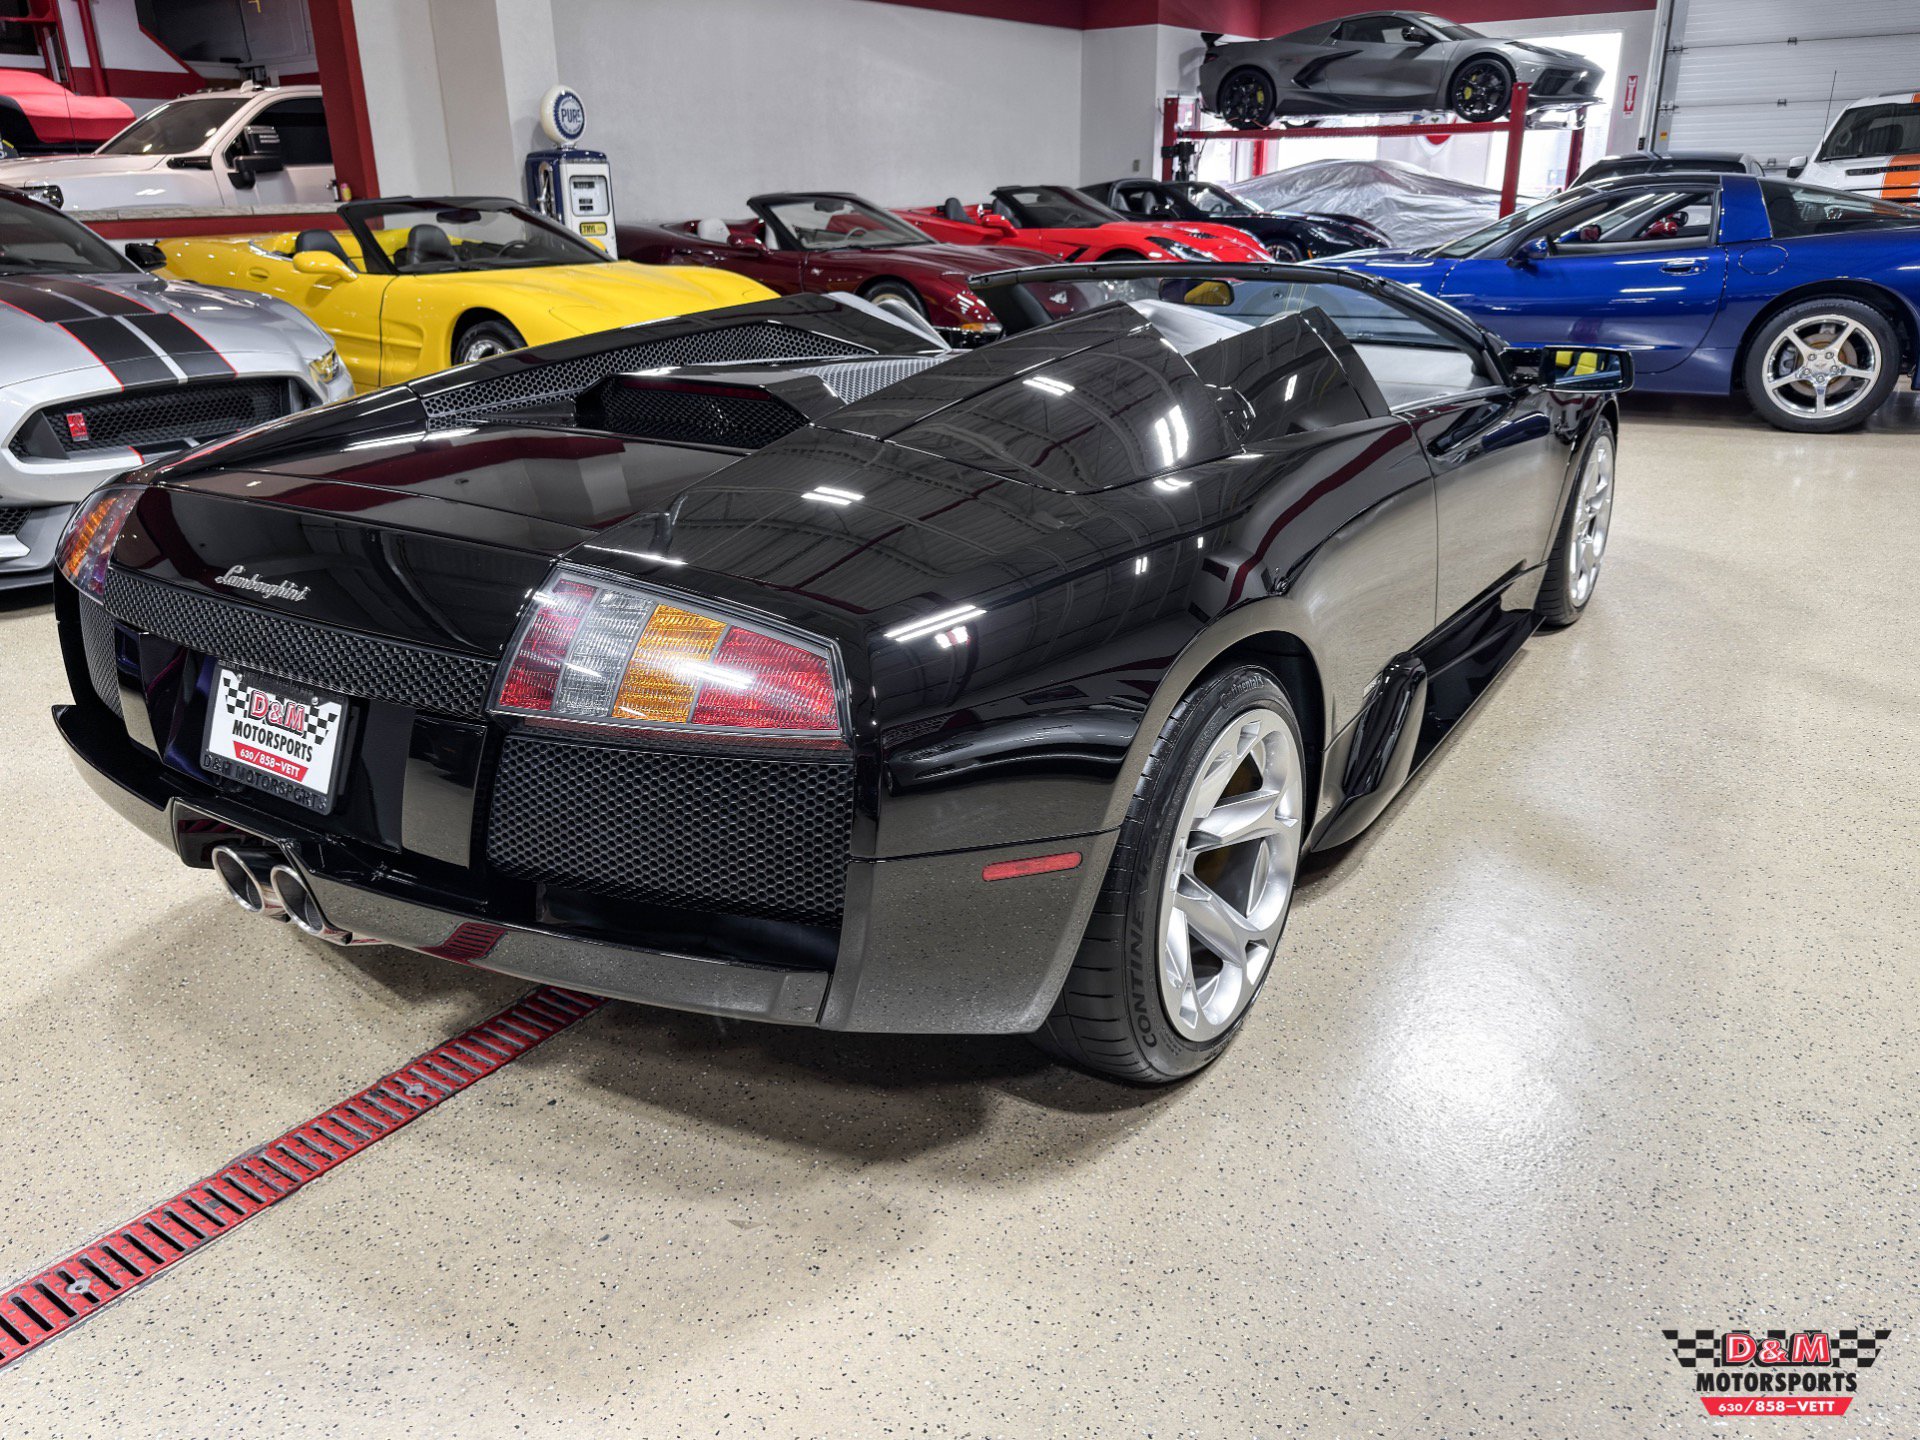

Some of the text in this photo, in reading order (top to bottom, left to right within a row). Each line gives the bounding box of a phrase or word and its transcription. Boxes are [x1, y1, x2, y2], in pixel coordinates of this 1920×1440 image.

[561, 108, 582, 123] PURE
[214, 564, 312, 601] Lamborghini
[250, 689, 306, 734] D&M
[232, 719, 313, 762] MOTORSPORTS
[235, 765, 327, 810] MOTORSPORTS
